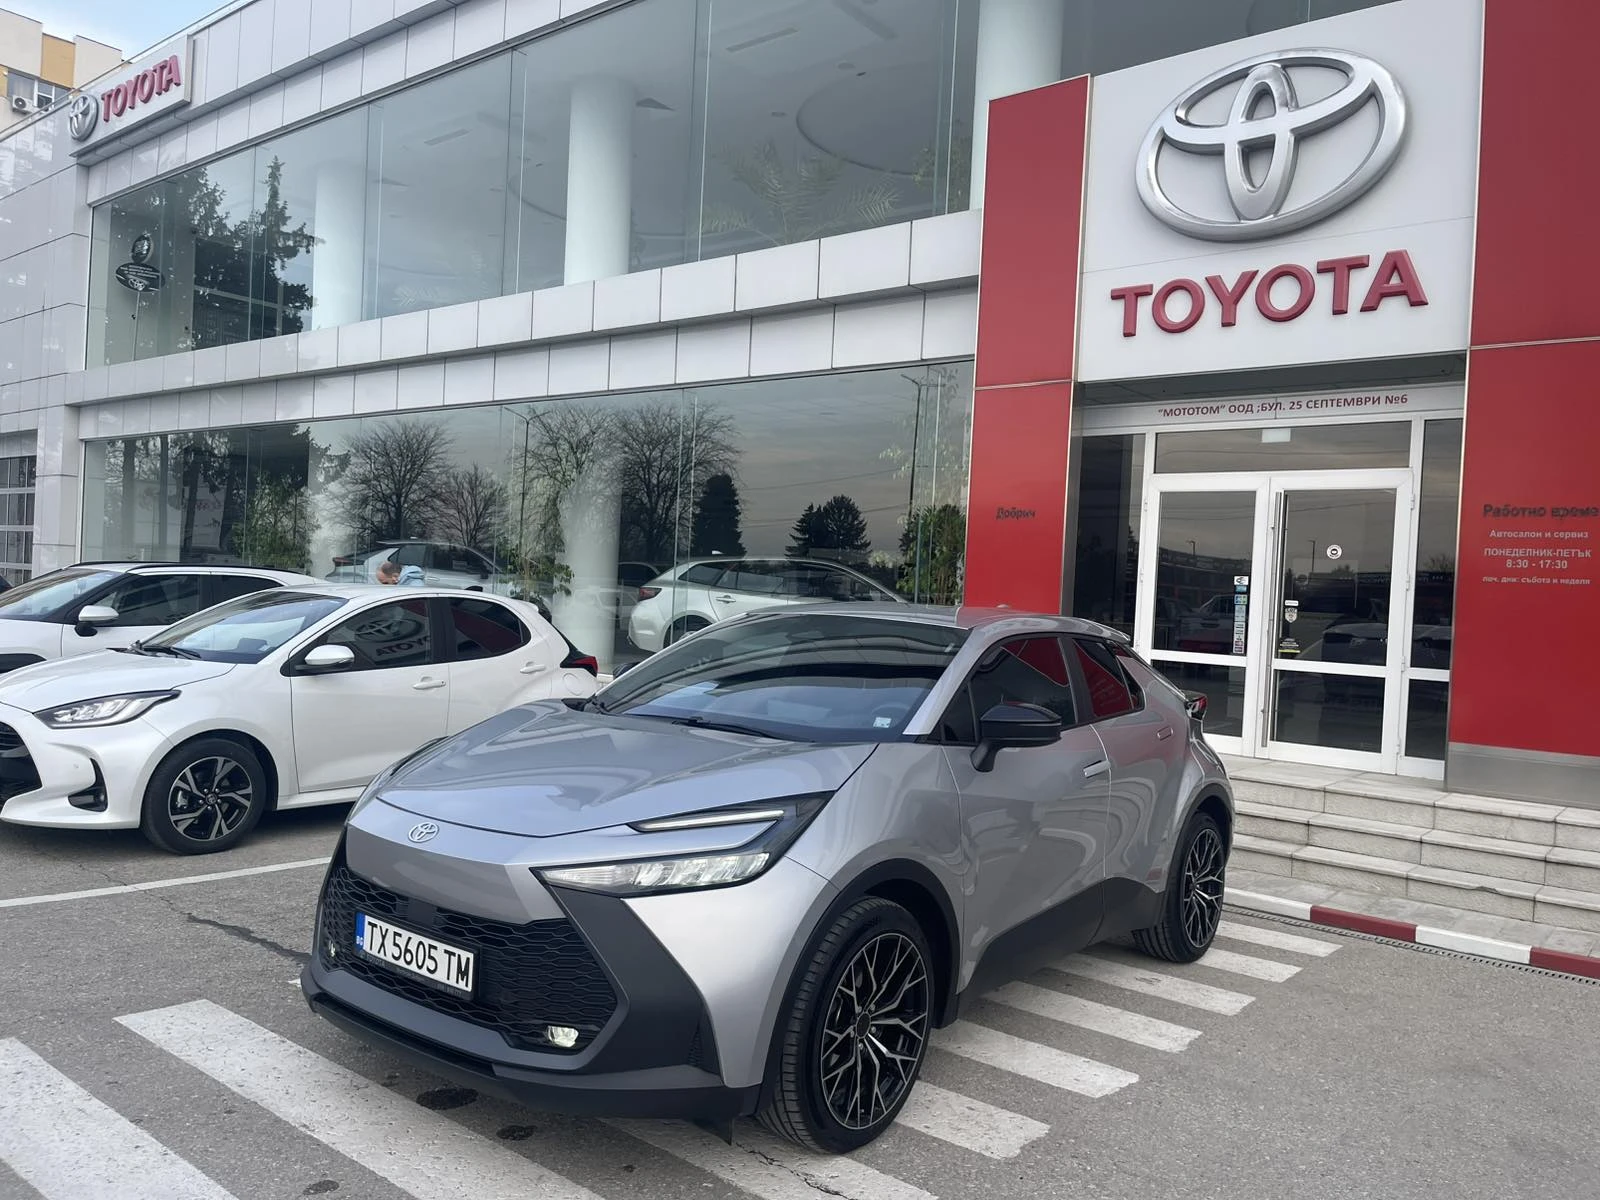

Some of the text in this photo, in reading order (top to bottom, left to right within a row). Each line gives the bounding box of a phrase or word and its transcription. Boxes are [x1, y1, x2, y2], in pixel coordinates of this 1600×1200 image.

[101, 55, 181, 123] TOYOTA
[1110, 249, 1429, 338] TOYOTA
[1228, 403, 1254, 414] ООД
[1289, 401, 1303, 410] 25
[1306, 396, 1381, 409] СЕПТЕМВРИ
[1483, 504, 1600, 520] Работно време
[1489, 530, 1542, 538] Автосалон
[1554, 531, 1589, 540] сервиз
[1484, 548, 1592, 558] ПОНЕДЕЛНИК-ПЕТЪК
[1506, 559, 1529, 569] 8:30
[1539, 560, 1568, 569] 17:30
[367, 921, 471, 988] TX 5605 TM
